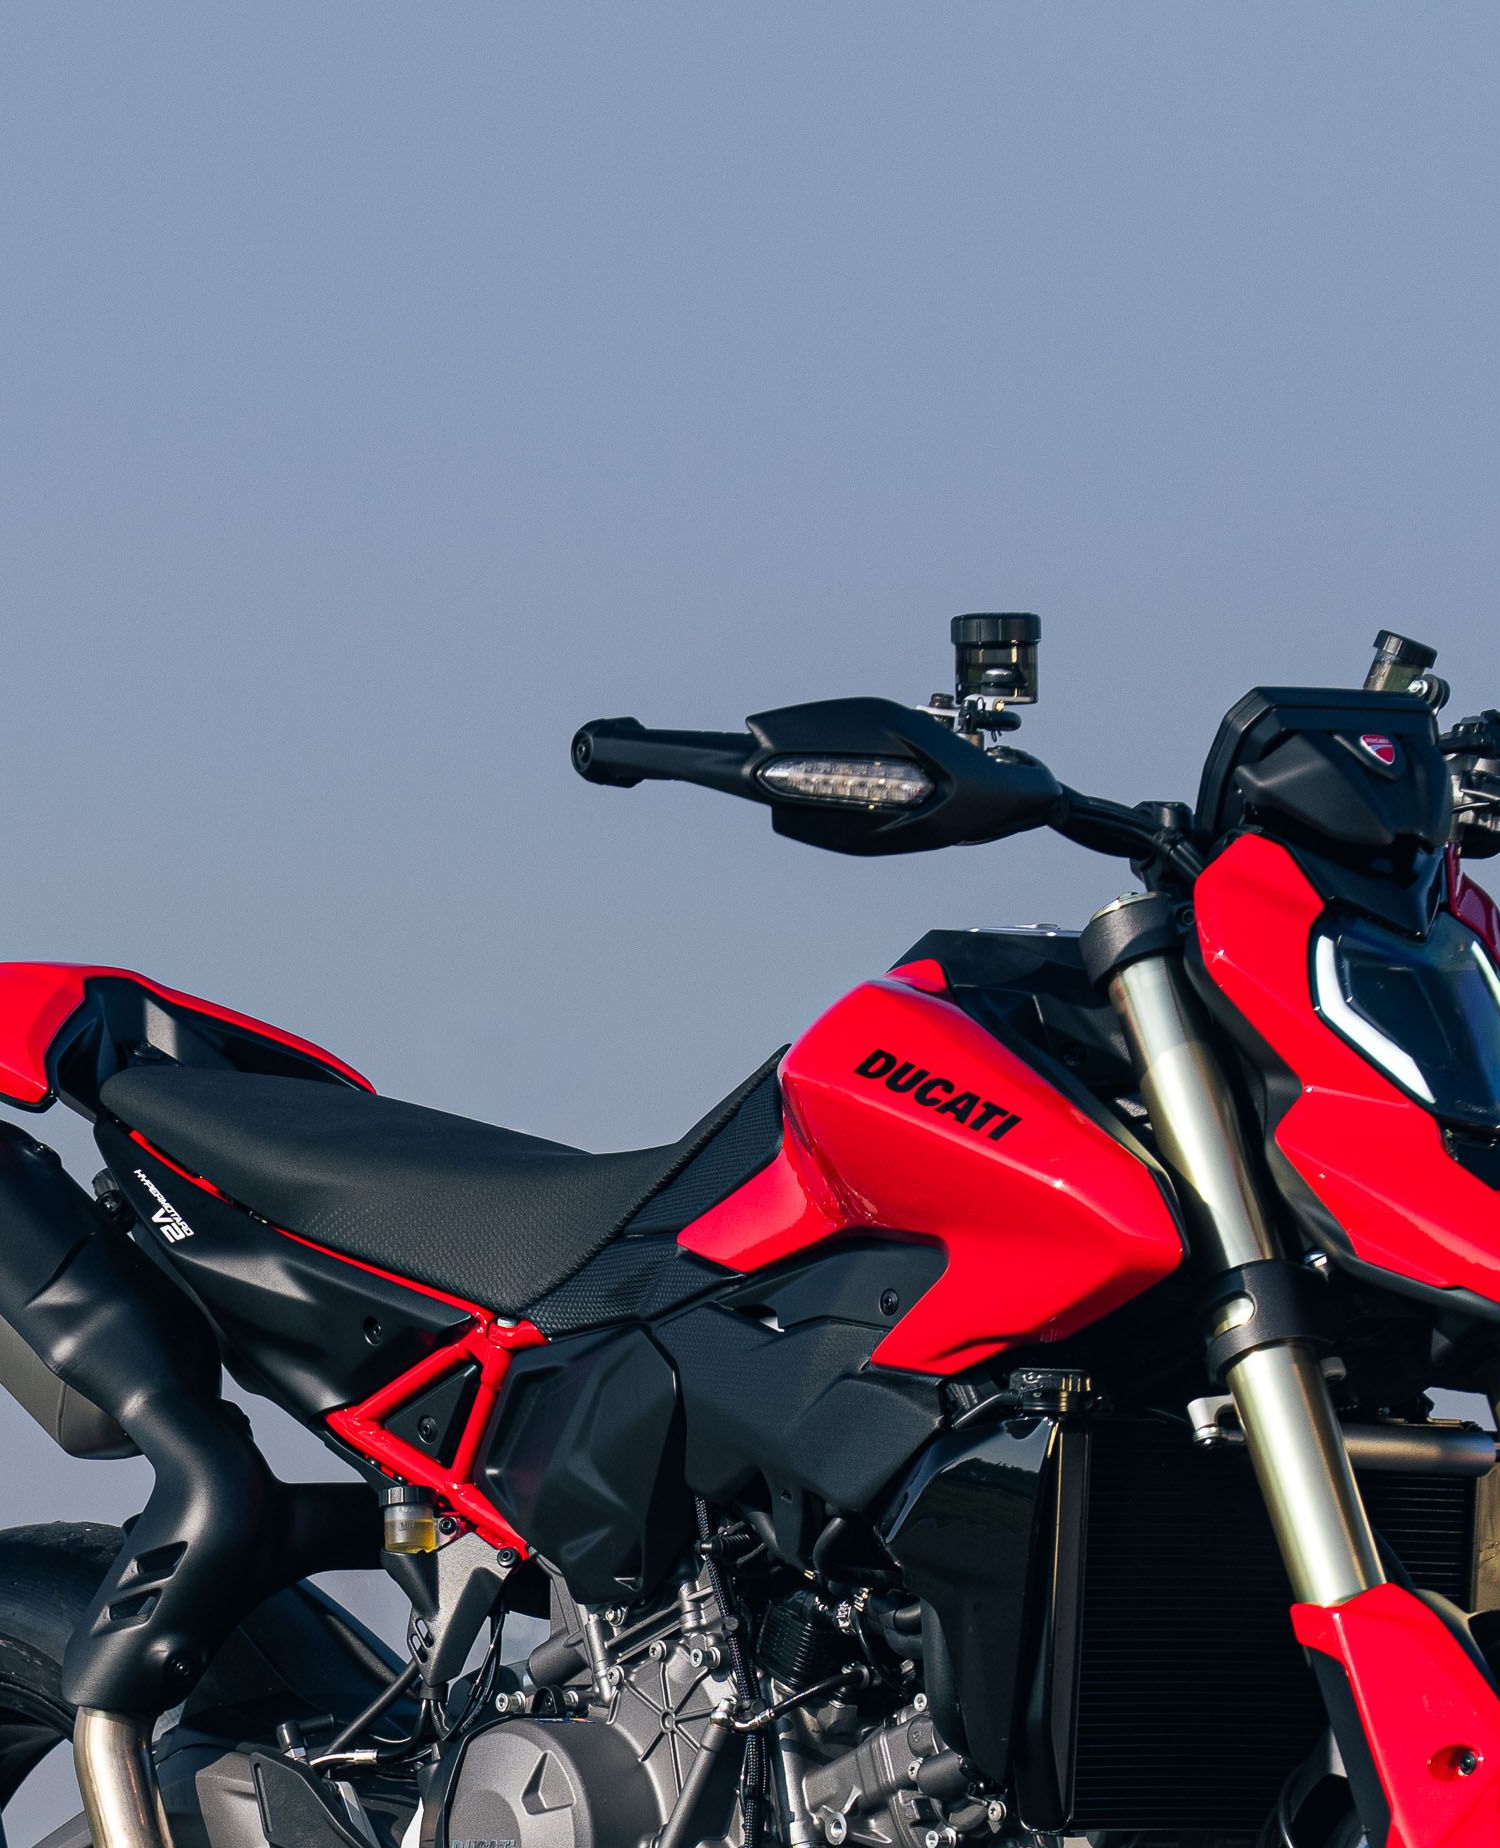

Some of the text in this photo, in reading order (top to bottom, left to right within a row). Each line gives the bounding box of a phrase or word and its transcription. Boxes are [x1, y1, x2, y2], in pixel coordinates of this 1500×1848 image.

[853, 1048, 1024, 1142] DUCATI
[133, 1168, 195, 1237] HYPERMOTARD
[151, 1208, 187, 1244] V2
